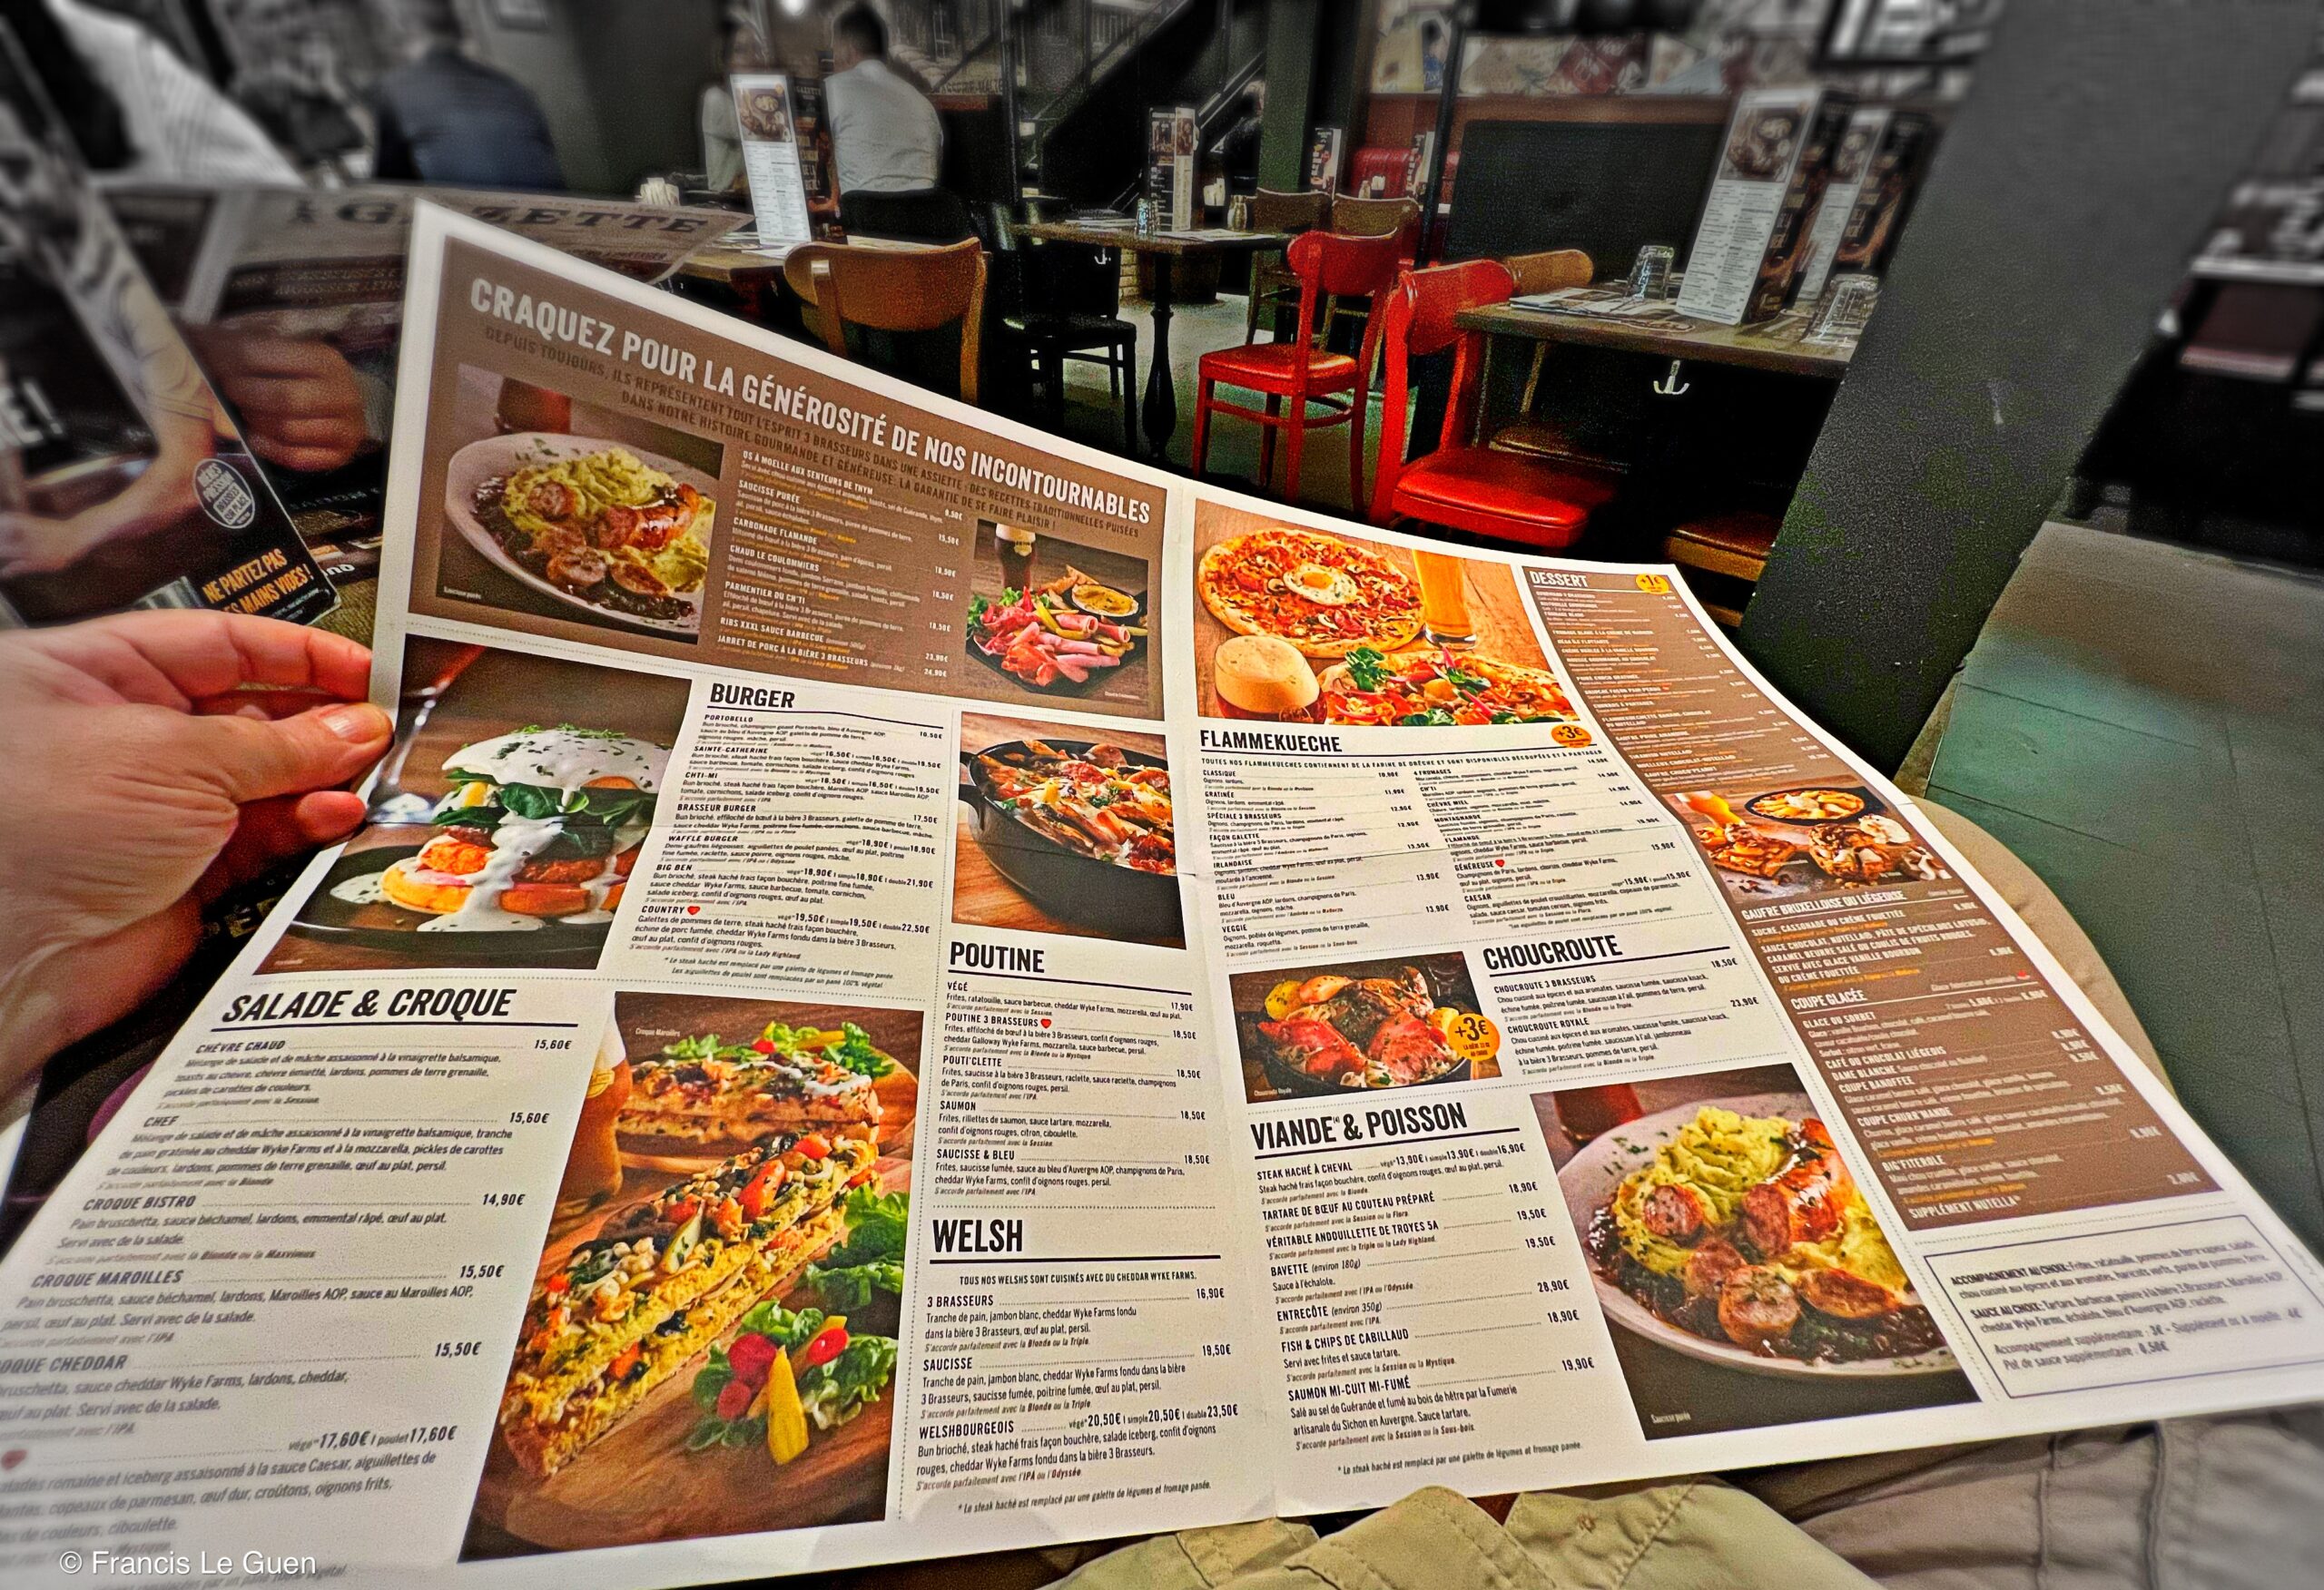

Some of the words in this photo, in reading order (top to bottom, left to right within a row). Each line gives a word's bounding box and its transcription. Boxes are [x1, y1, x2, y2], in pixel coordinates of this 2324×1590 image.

[336, 200, 708, 234] GZETTE
[470, 279, 615, 356] CRAQUEZ
[623, 331, 696, 383] POUR
[704, 359, 734, 397] LA
[742, 370, 886, 446] GÉNÉROSITÉ
[891, 426, 920, 456] DE
[925, 436, 966, 471] NOS
[971, 451, 1150, 524] INCONTOURNABLES
[486, 328, 536, 354] DEPUIS
[635, 377, 724, 414] REPRÉSENTENT
[813, 436, 872, 464] BRASSEURS
[873, 454, 898, 472] DANS
[921, 466, 961, 491] ASSIETTE
[970, 482, 986, 496] DES
[989, 488, 1030, 510] RECETTES
[1033, 501, 1104, 530] TRADITIONNELLES
[1107, 517, 1138, 537] PUISÉES
[622, 390, 654, 414] DANS
[658, 402, 695, 426] NOTRE
[700, 415, 750, 441] HISTOIRE
[754, 429, 820, 464] GOURMANDE
[914, 482, 960, 507] GARANTIE
[990, 504, 1014, 521] FAIRE
[1017, 512, 1049, 529] PLAISIR
[739, 480, 774, 496] SAUCISSE
[776, 490, 800, 504] PURÉE
[734, 517, 777, 536] CARBONADE
[780, 529, 817, 545] FLAMANDE
[202, 585, 225, 603] NE
[220, 560, 268, 594] PARTEZ
[261, 548, 288, 573] PAS
[1530, 571, 1588, 588] DESSERT
[239, 584, 280, 613] MAINS
[274, 570, 310, 594] VIDES
[721, 617, 739, 629] RIBS
[761, 625, 783, 636] SAUCE
[786, 628, 823, 642] BARBECUE
[718, 635, 744, 646] JARRET
[759, 643, 778, 653] PORC
[798, 647, 819, 659] BIÈRE
[827, 653, 868, 666] BRASSEURS
[710, 683, 795, 709] BURGER
[704, 714, 753, 722] PORTOBELLO
[1200, 730, 1342, 752] FLAMMEKUECHE
[913, 814, 938, 824] 17,50€
[704, 835, 738, 843] BURGER
[1454, 860, 1494, 871] GÉNÉREUSE
[1650, 842, 1675, 851] 15,90€
[1416, 873, 1439, 881] 13,90€
[641, 906, 685, 915] COUNTRY
[1464, 893, 1492, 902] CAESAR
[1742, 906, 1781, 920] GAUFRE
[1783, 898, 1841, 916] BRUXELLOISE
[1222, 924, 1247, 933] VEGGIE
[1426, 905, 1449, 913] 13,90€
[950, 941, 1045, 974] POUTINE
[1482, 935, 1622, 971] CHOUCROUTE
[1493, 980, 1543, 994] CHOUCROUTE
[1552, 976, 1596, 987] BRASSEURS
[1710, 958, 1738, 969] 18,50€
[222, 990, 352, 1023] SALADE
[351, 990, 381, 1016] &
[388, 988, 517, 1022] CROQUE
[947, 981, 969, 992] VÉGÉ
[1171, 1002, 1194, 1011] 17,90€
[1790, 995, 1825, 1010] COUPE
[1827, 989, 1867, 1006] GLACÉE
[945, 1013, 982, 1025] POUTINE
[990, 1015, 1039, 1027] BRASSEURS
[1173, 1029, 1196, 1039] 18,50€
[1507, 1022, 1558, 1035] CHOUCROUTE
[1561, 1017, 1590, 1029] ROYALE
[1730, 996, 1759, 1008] 23,90€
[1455, 1017, 1489, 1041] +3€
[196, 1041, 245, 1054] CHÈVRE
[247, 1040, 286, 1051] CHAUD
[534, 1039, 572, 1051] 15,60€
[943, 1055, 1002, 1067] POUTI'CLETTE
[1177, 1069, 1201, 1079] 18,50€
[143, 1115, 180, 1127] CHEF
[509, 1112, 549, 1124] 15,60€
[940, 1101, 976, 1111] SAUMON
[1180, 1110, 1206, 1120] 18,50€
[1343, 1114, 1363, 1140] &
[1365, 1102, 1467, 1138] POISSON
[937, 1149, 980, 1160] SAUCISSE
[992, 1150, 1015, 1161] BLEU
[1184, 1154, 1210, 1164] 18,50€
[1257, 1168, 1284, 1181] STEAK
[1285, 1163, 1313, 1178] HACHÉ
[1322, 1162, 1353, 1173] CHEVAL
[83, 1197, 143, 1212] CROQUE
[143, 1195, 197, 1209] BISTRO
[482, 1192, 526, 1207] 14,90€
[1263, 1208, 1299, 1221] TARTARE
[1315, 1202, 1341, 1216] BŒUF
[1355, 1197, 1394, 1211] COUTEAU
[1396, 1191, 1435, 1206] PRÉPARÉ
[1509, 1182, 1538, 1193] 18,90€
[1908, 1200, 1971, 1220] SUPPLÉMENT
[932, 1219, 1023, 1253] WELSH
[1266, 1233, 1313, 1249] VÉRITABLE
[1315, 1227, 1377, 1243] ANDOUILLETTE
[1393, 1222, 1426, 1235] TROYES
[1517, 1209, 1547, 1221] 19,50€
[1271, 1263, 1309, 1277] BAVETTE
[1312, 1261, 1339, 1272] (environ
[1341, 1259, 1361, 1271] 180g)
[1525, 1236, 1556, 1249] 19,50€
[31, 1272, 95, 1288] CROQUE
[96, 1270, 184, 1286] MAROILLES
[459, 1264, 505, 1280] 15,50€
[960, 1275, 980, 1285] TOUS
[981, 1275, 997, 1284] NOS
[998, 1274, 1028, 1284] WELSHS
[1029, 1274, 1049, 1283] SONT
[1050, 1272, 1084, 1283] CUISINÉS
[1086, 1273, 1104, 1282] AVEC
[1117, 1271, 1149, 1281] CHEDDAR
[1150, 1271, 1170, 1281] WYKE
[1172, 1271, 1197, 1281] FARMS.
[1950, 1268, 2026, 1287] ACCOMPAGNEMENT
[936, 1295, 994, 1308] BRASSEURS
[1196, 1288, 1225, 1300] 16,90€
[1277, 1305, 1329, 1321] ENTRECÔTE
[1332, 1304, 1360, 1317] (environ
[1362, 1301, 1383, 1314] 350g)
[1537, 1280, 1570, 1293] 28,90€
[1281, 1340, 1304, 1352] FISH
[1315, 1336, 1343, 1349] CHIPS
[1359, 1329, 1409, 1344] CABILLAUD
[1547, 1310, 1580, 1323] 18,90€
[53, 1355, 128, 1373] CHEDDAR
[434, 1341, 482, 1359] 15,50€
[923, 1358, 973, 1371] SAUCISSE
[1202, 1344, 1231, 1356] 19,50€
[922, 1375, 955, 1389] Tranche
[1043, 1369, 1073, 1380] cheddar
[1119, 1365, 1140, 1376] fondu
[1288, 1387, 1327, 1401] SAUMON
[1330, 1381, 1367, 1397] MI-CUIT
[1369, 1376, 1411, 1393] MI-FUMÉ
[1561, 1358, 1594, 1371] 19,90€
[919, 1420, 1015, 1440] WELSHBOURGEOIS
